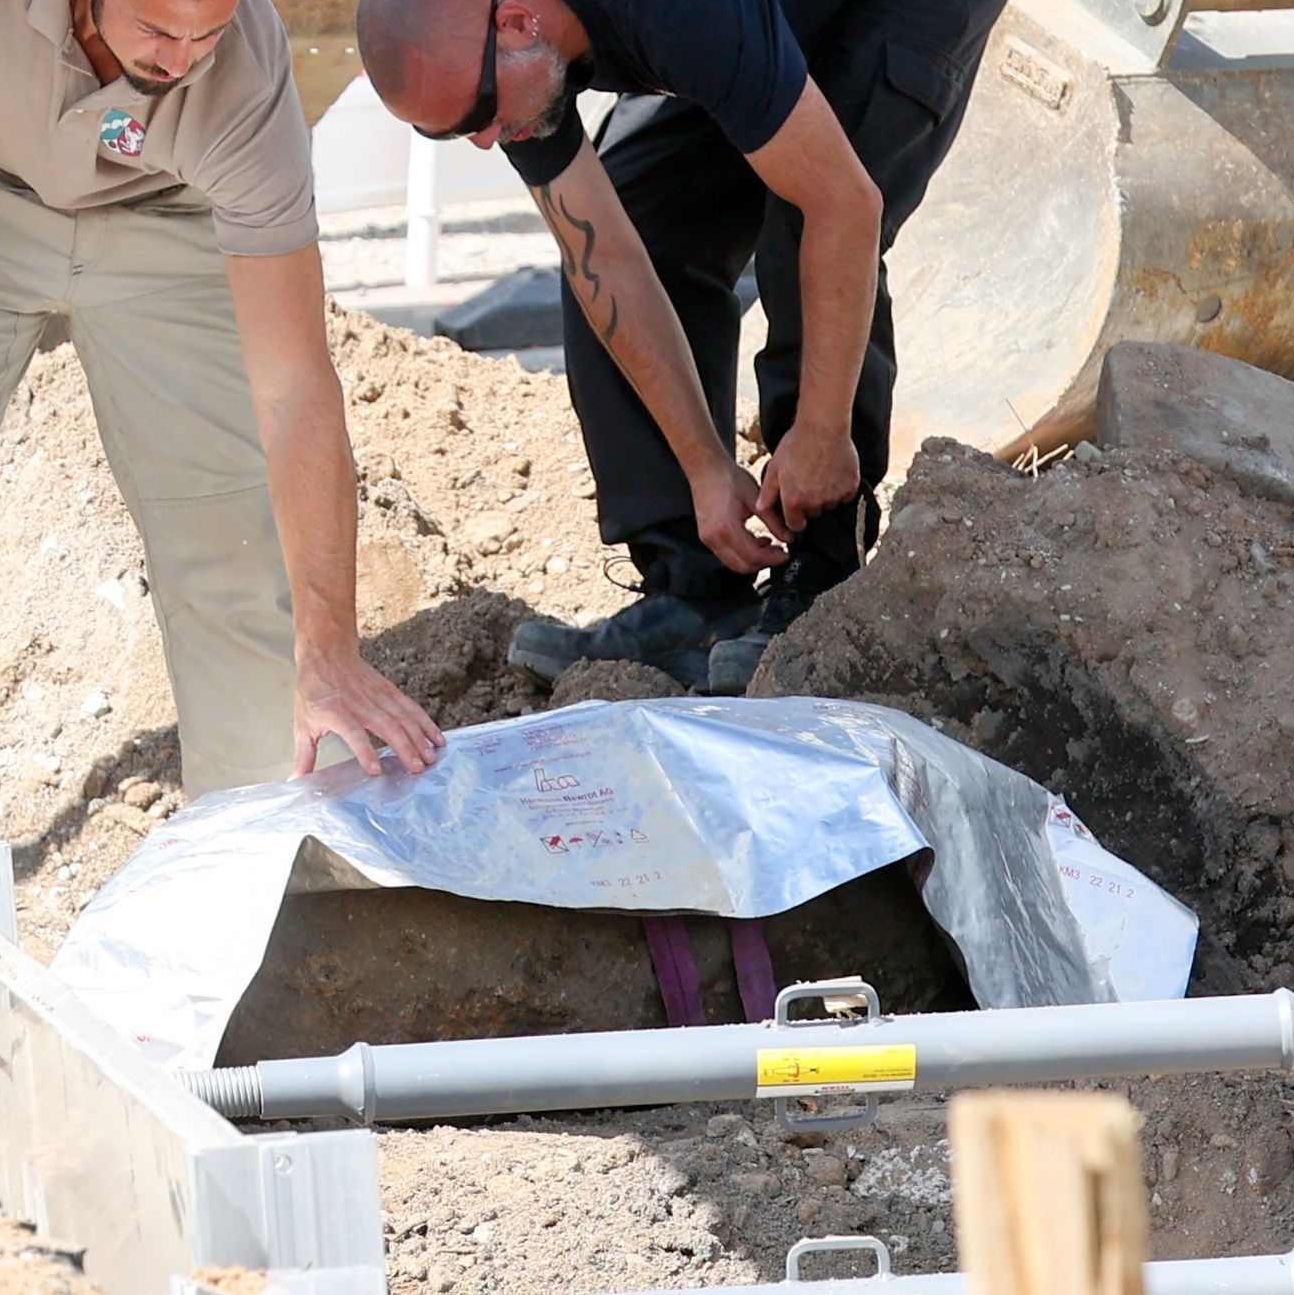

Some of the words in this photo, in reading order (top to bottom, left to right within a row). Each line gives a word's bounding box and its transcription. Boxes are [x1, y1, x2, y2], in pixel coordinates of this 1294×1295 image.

[1058, 865, 1081, 880] KM3
[1089, 875, 1103, 887] 22
[1108, 881, 1121, 895] 21
[1127, 888, 1135, 899] 2
